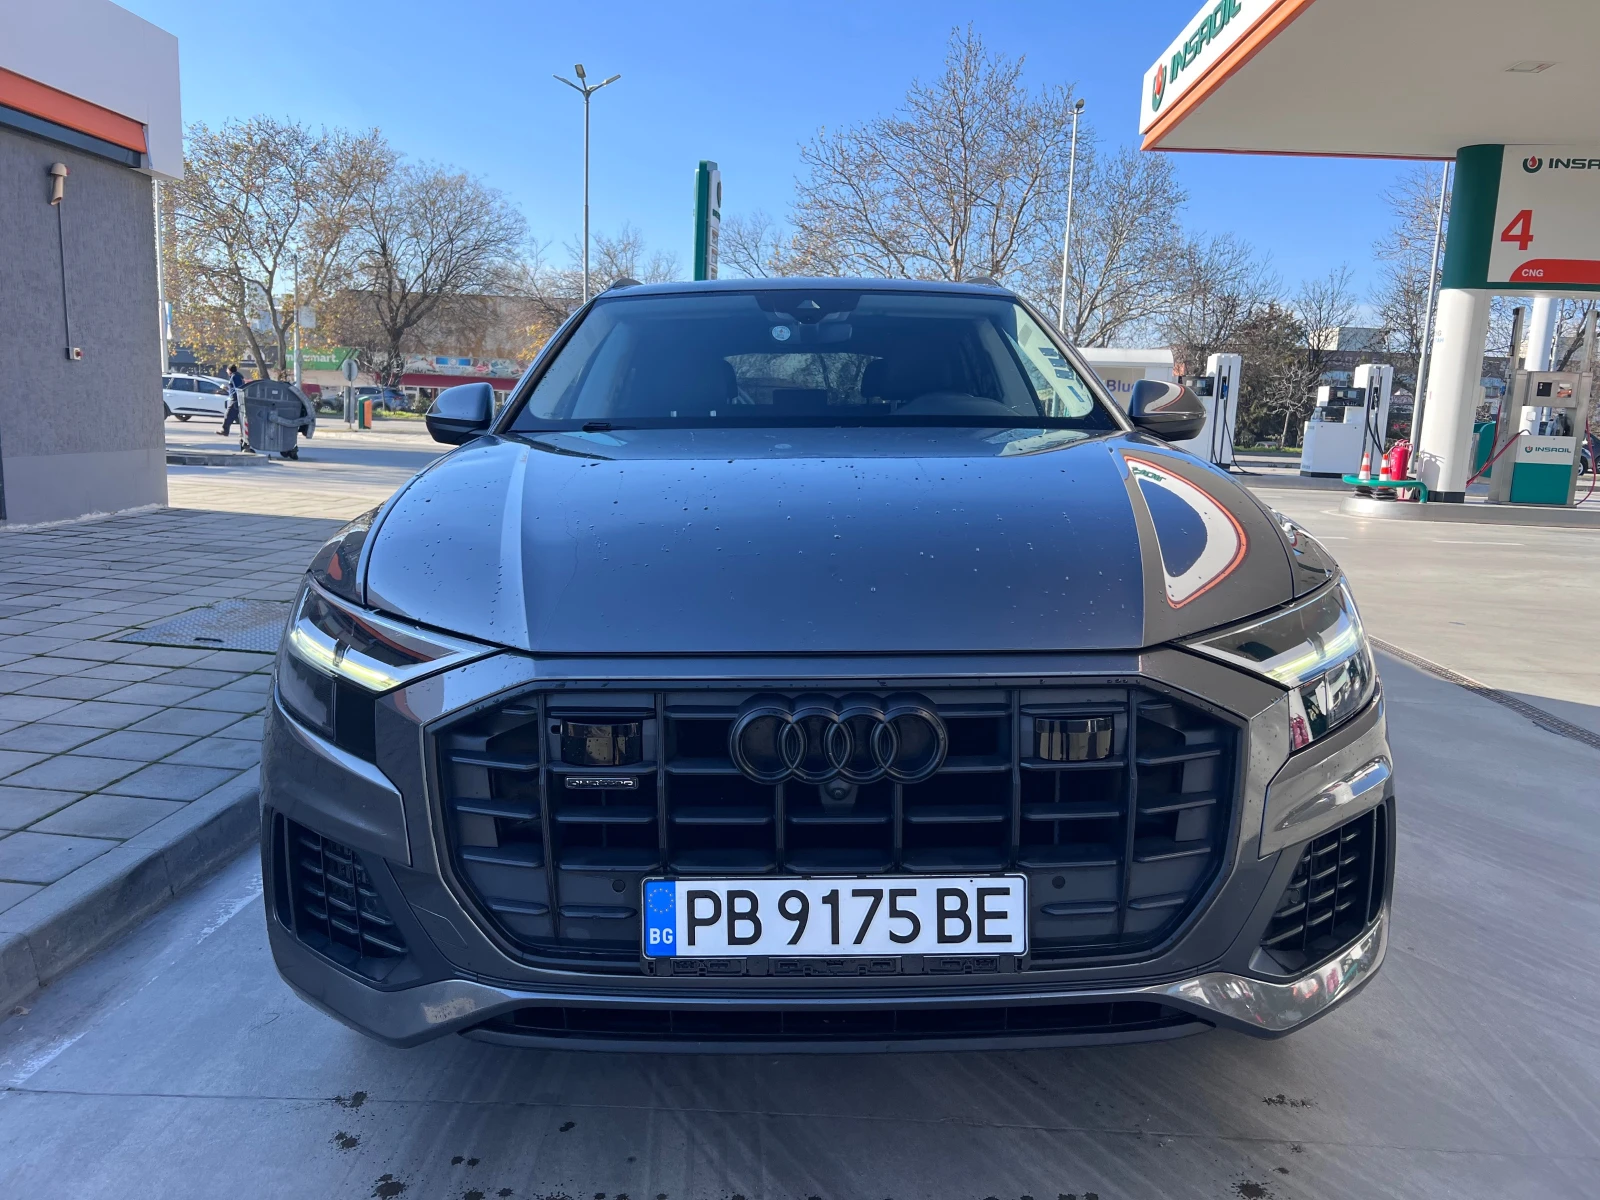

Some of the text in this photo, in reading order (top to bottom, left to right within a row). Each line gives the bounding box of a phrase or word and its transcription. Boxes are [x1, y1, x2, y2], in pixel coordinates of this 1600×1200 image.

[1501, 209, 1534, 251] 4
[1521, 268, 1544, 277] CNG
[1534, 446, 1572, 454] INSAOIL
[686, 887, 1013, 946] PB 9175 BE
[649, 927, 673, 945] BG
